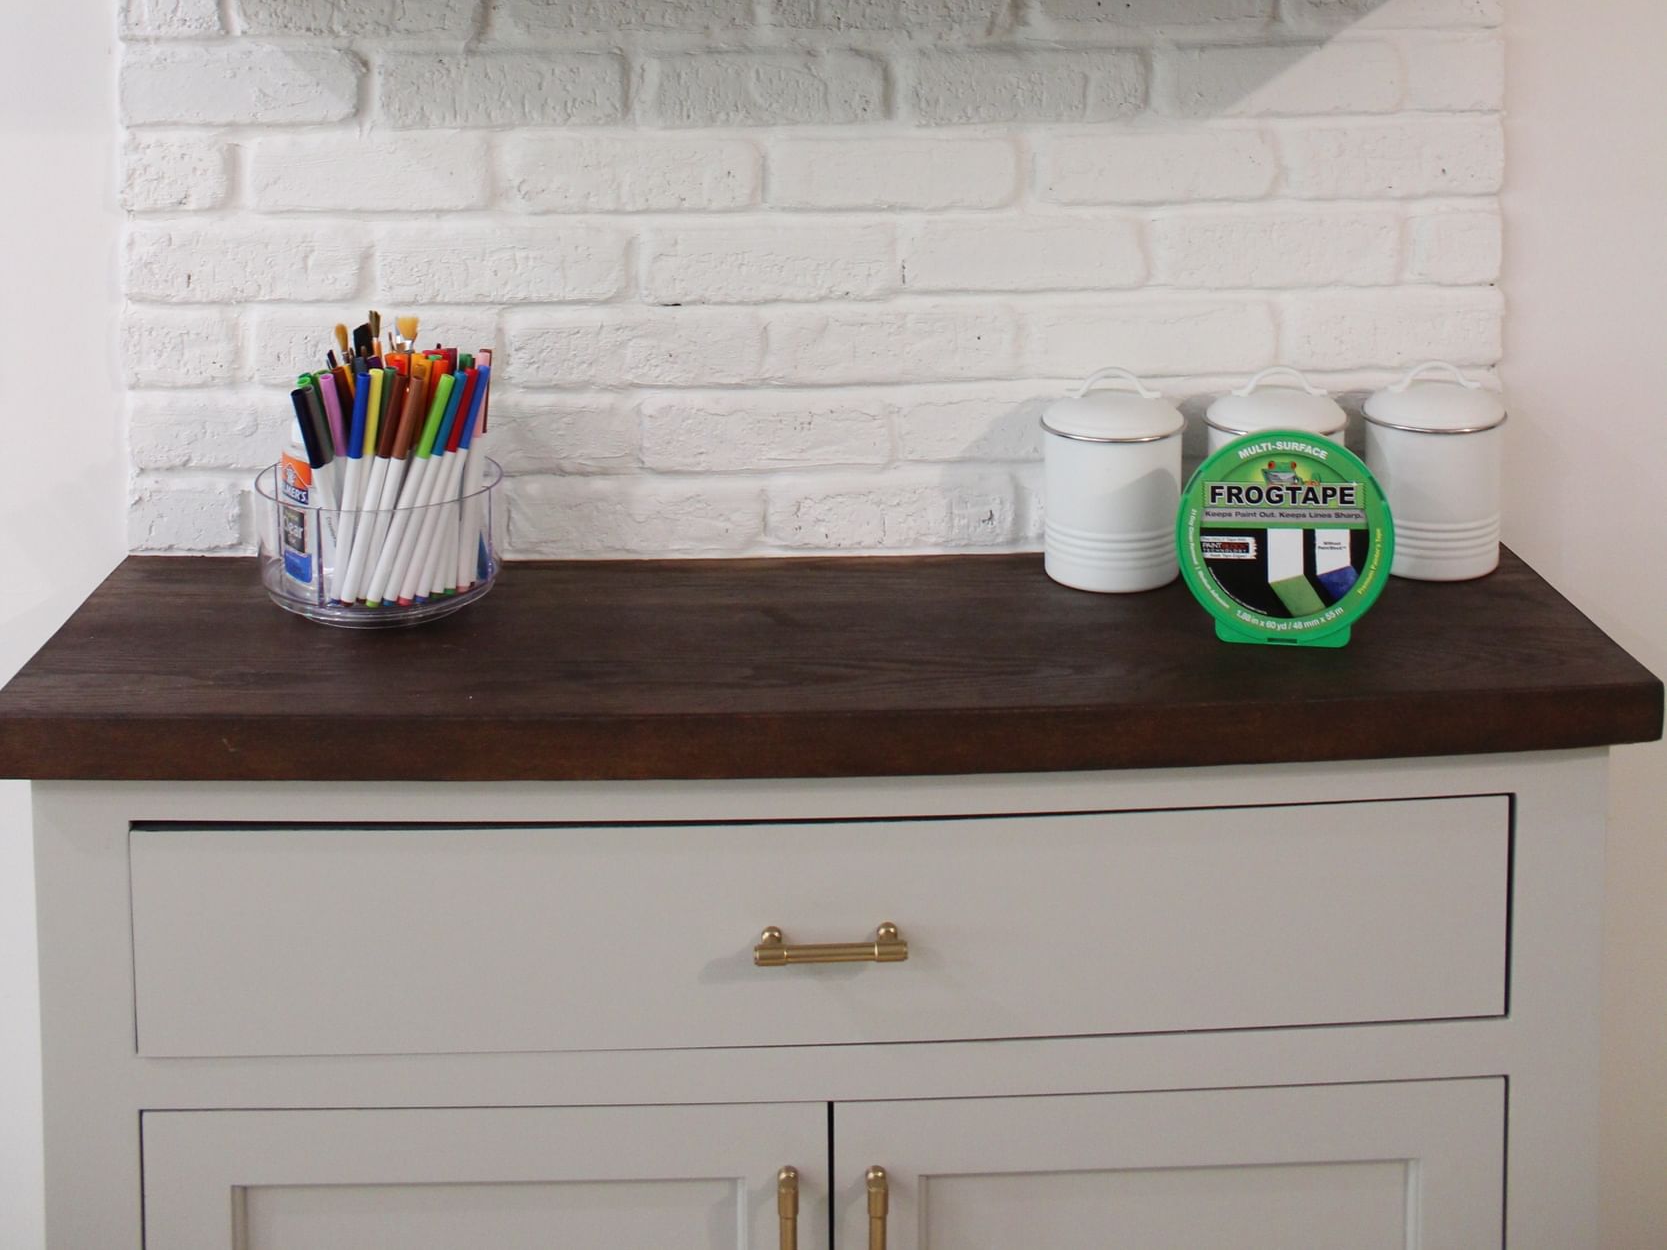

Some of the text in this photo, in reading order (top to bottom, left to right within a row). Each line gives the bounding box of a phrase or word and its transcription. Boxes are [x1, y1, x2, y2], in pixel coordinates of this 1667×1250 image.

[1238, 441, 1329, 460] MULTI-SURFACE
[1209, 485, 1356, 505] FROGTAPE
[1188, 515, 1197, 527] Day
[1204, 510, 1233, 518] Keeps
[1334, 512, 1364, 520] Sharp.
[1374, 527, 1382, 543] Tape
